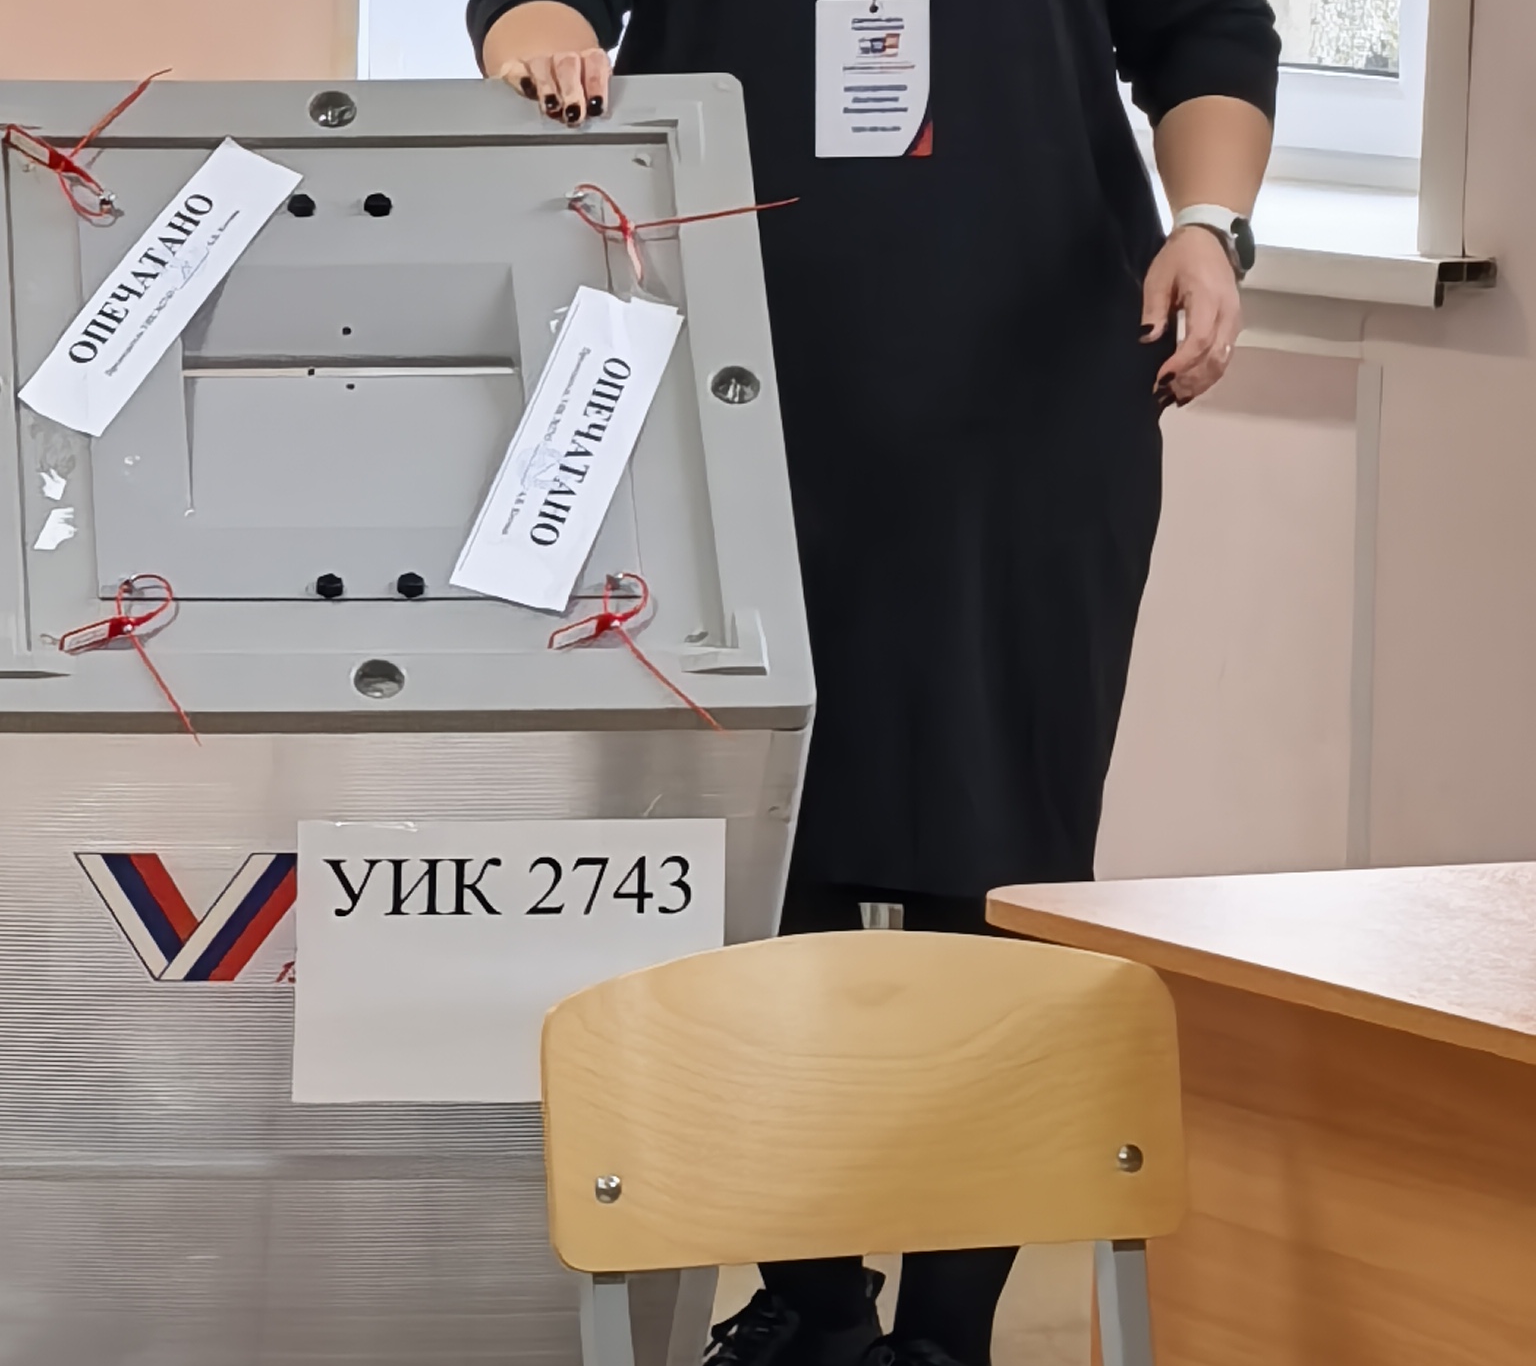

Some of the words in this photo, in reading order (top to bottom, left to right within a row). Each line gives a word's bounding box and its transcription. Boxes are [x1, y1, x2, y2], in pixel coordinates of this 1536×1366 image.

[68, 193, 214, 364] ОПЕЧАТАНО
[529, 357, 632, 547] ОПЕЧАТАНО
[322, 857, 502, 917] УИК
[525, 855, 693, 916] 2743
